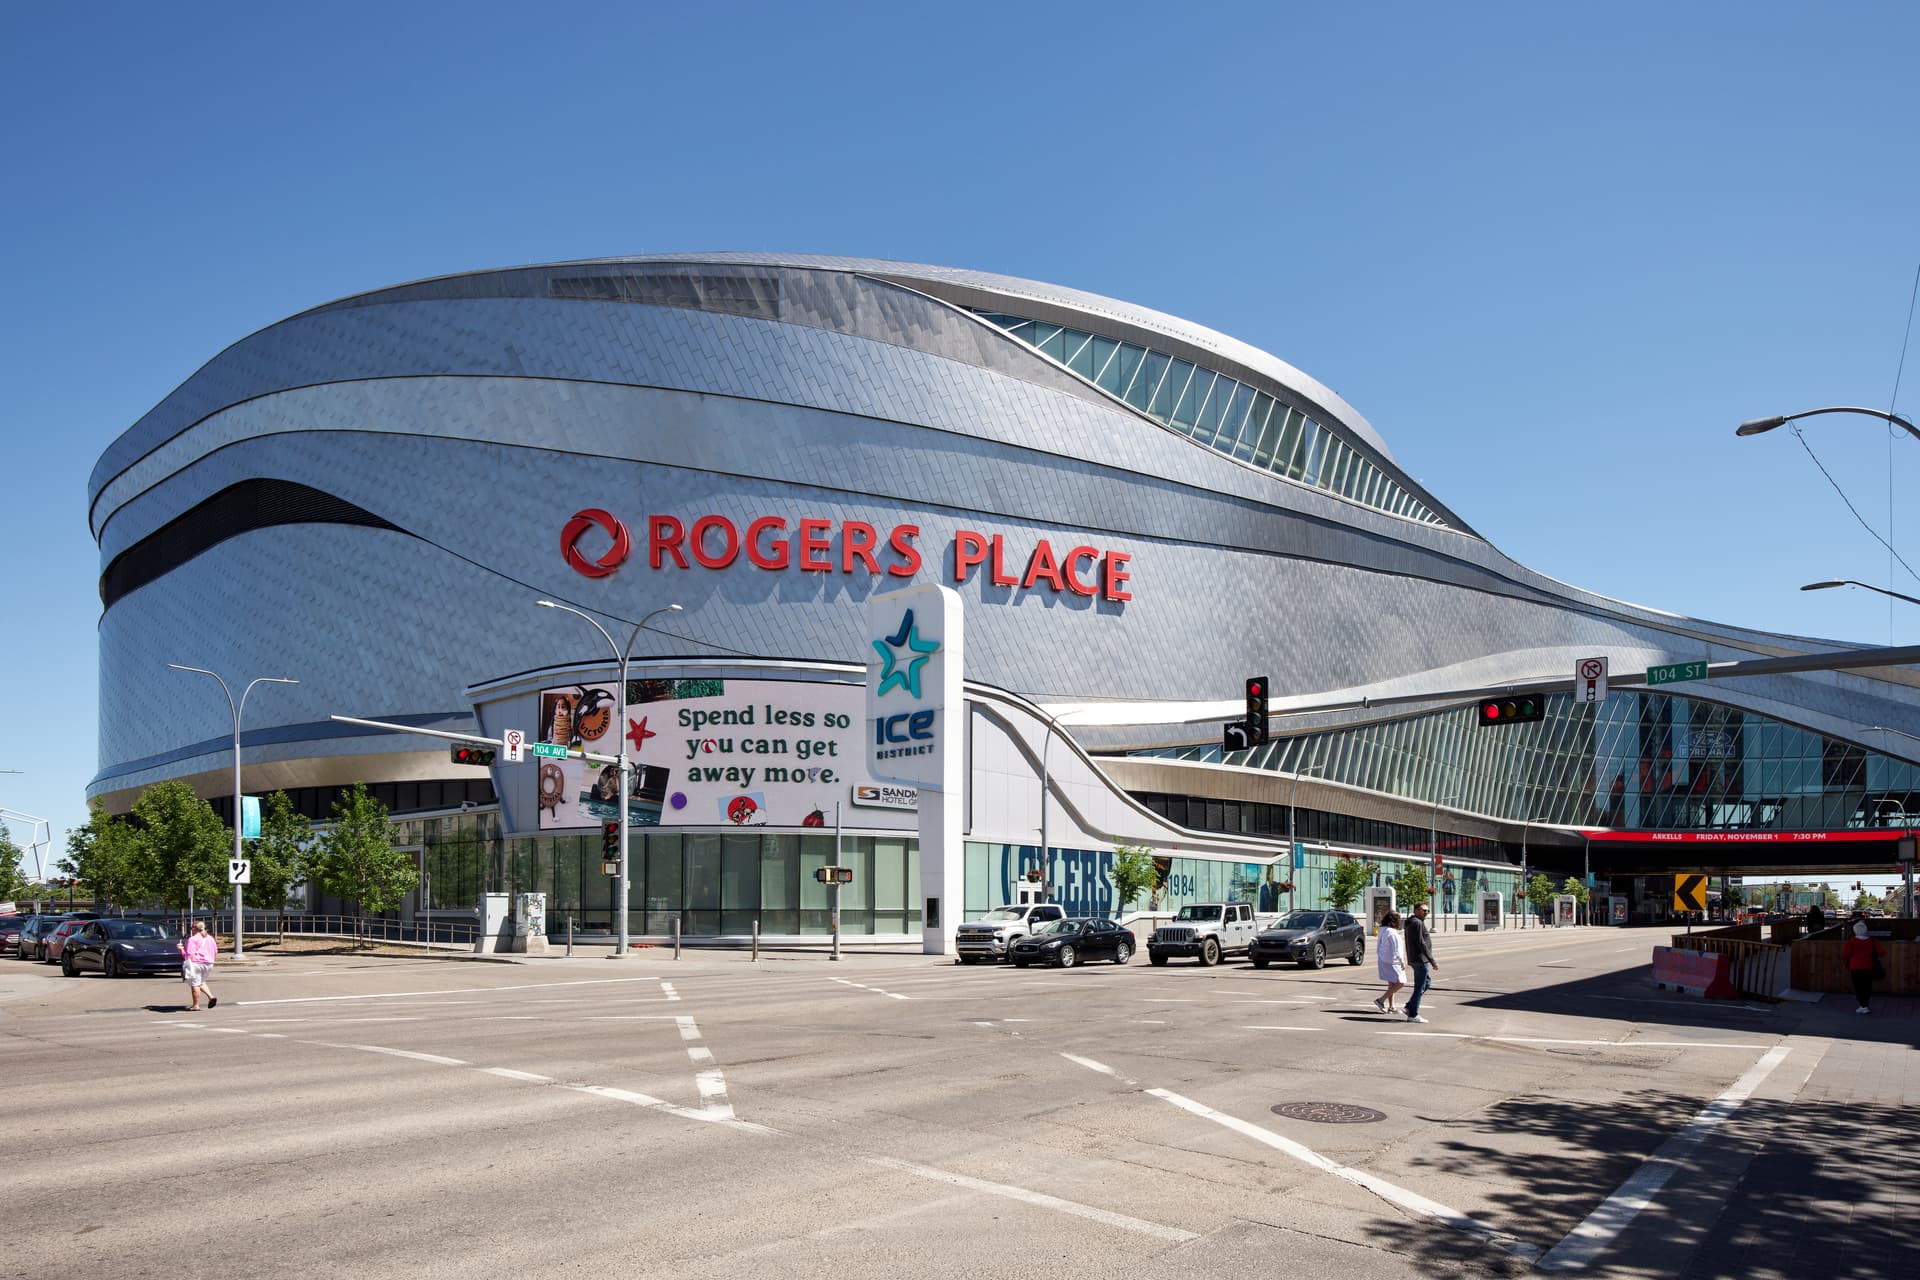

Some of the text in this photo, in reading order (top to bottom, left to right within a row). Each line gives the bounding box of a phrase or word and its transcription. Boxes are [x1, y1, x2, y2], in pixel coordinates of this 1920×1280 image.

[648, 515, 1132, 602] ROGERS PLACE
[1652, 665, 1701, 681] 104 ST
[678, 704, 851, 731] Spend less so
[535, 745, 567, 757] 104 AVE
[741, 737, 788, 754] can
[796, 738, 838, 760] get
[876, 744, 935, 760] DISTRICT
[688, 766, 756, 788] away
[881, 796, 908, 805] HOTEL
[1696, 833, 1726, 842] FRIDAY,
[1169, 874, 1194, 897] 1984
